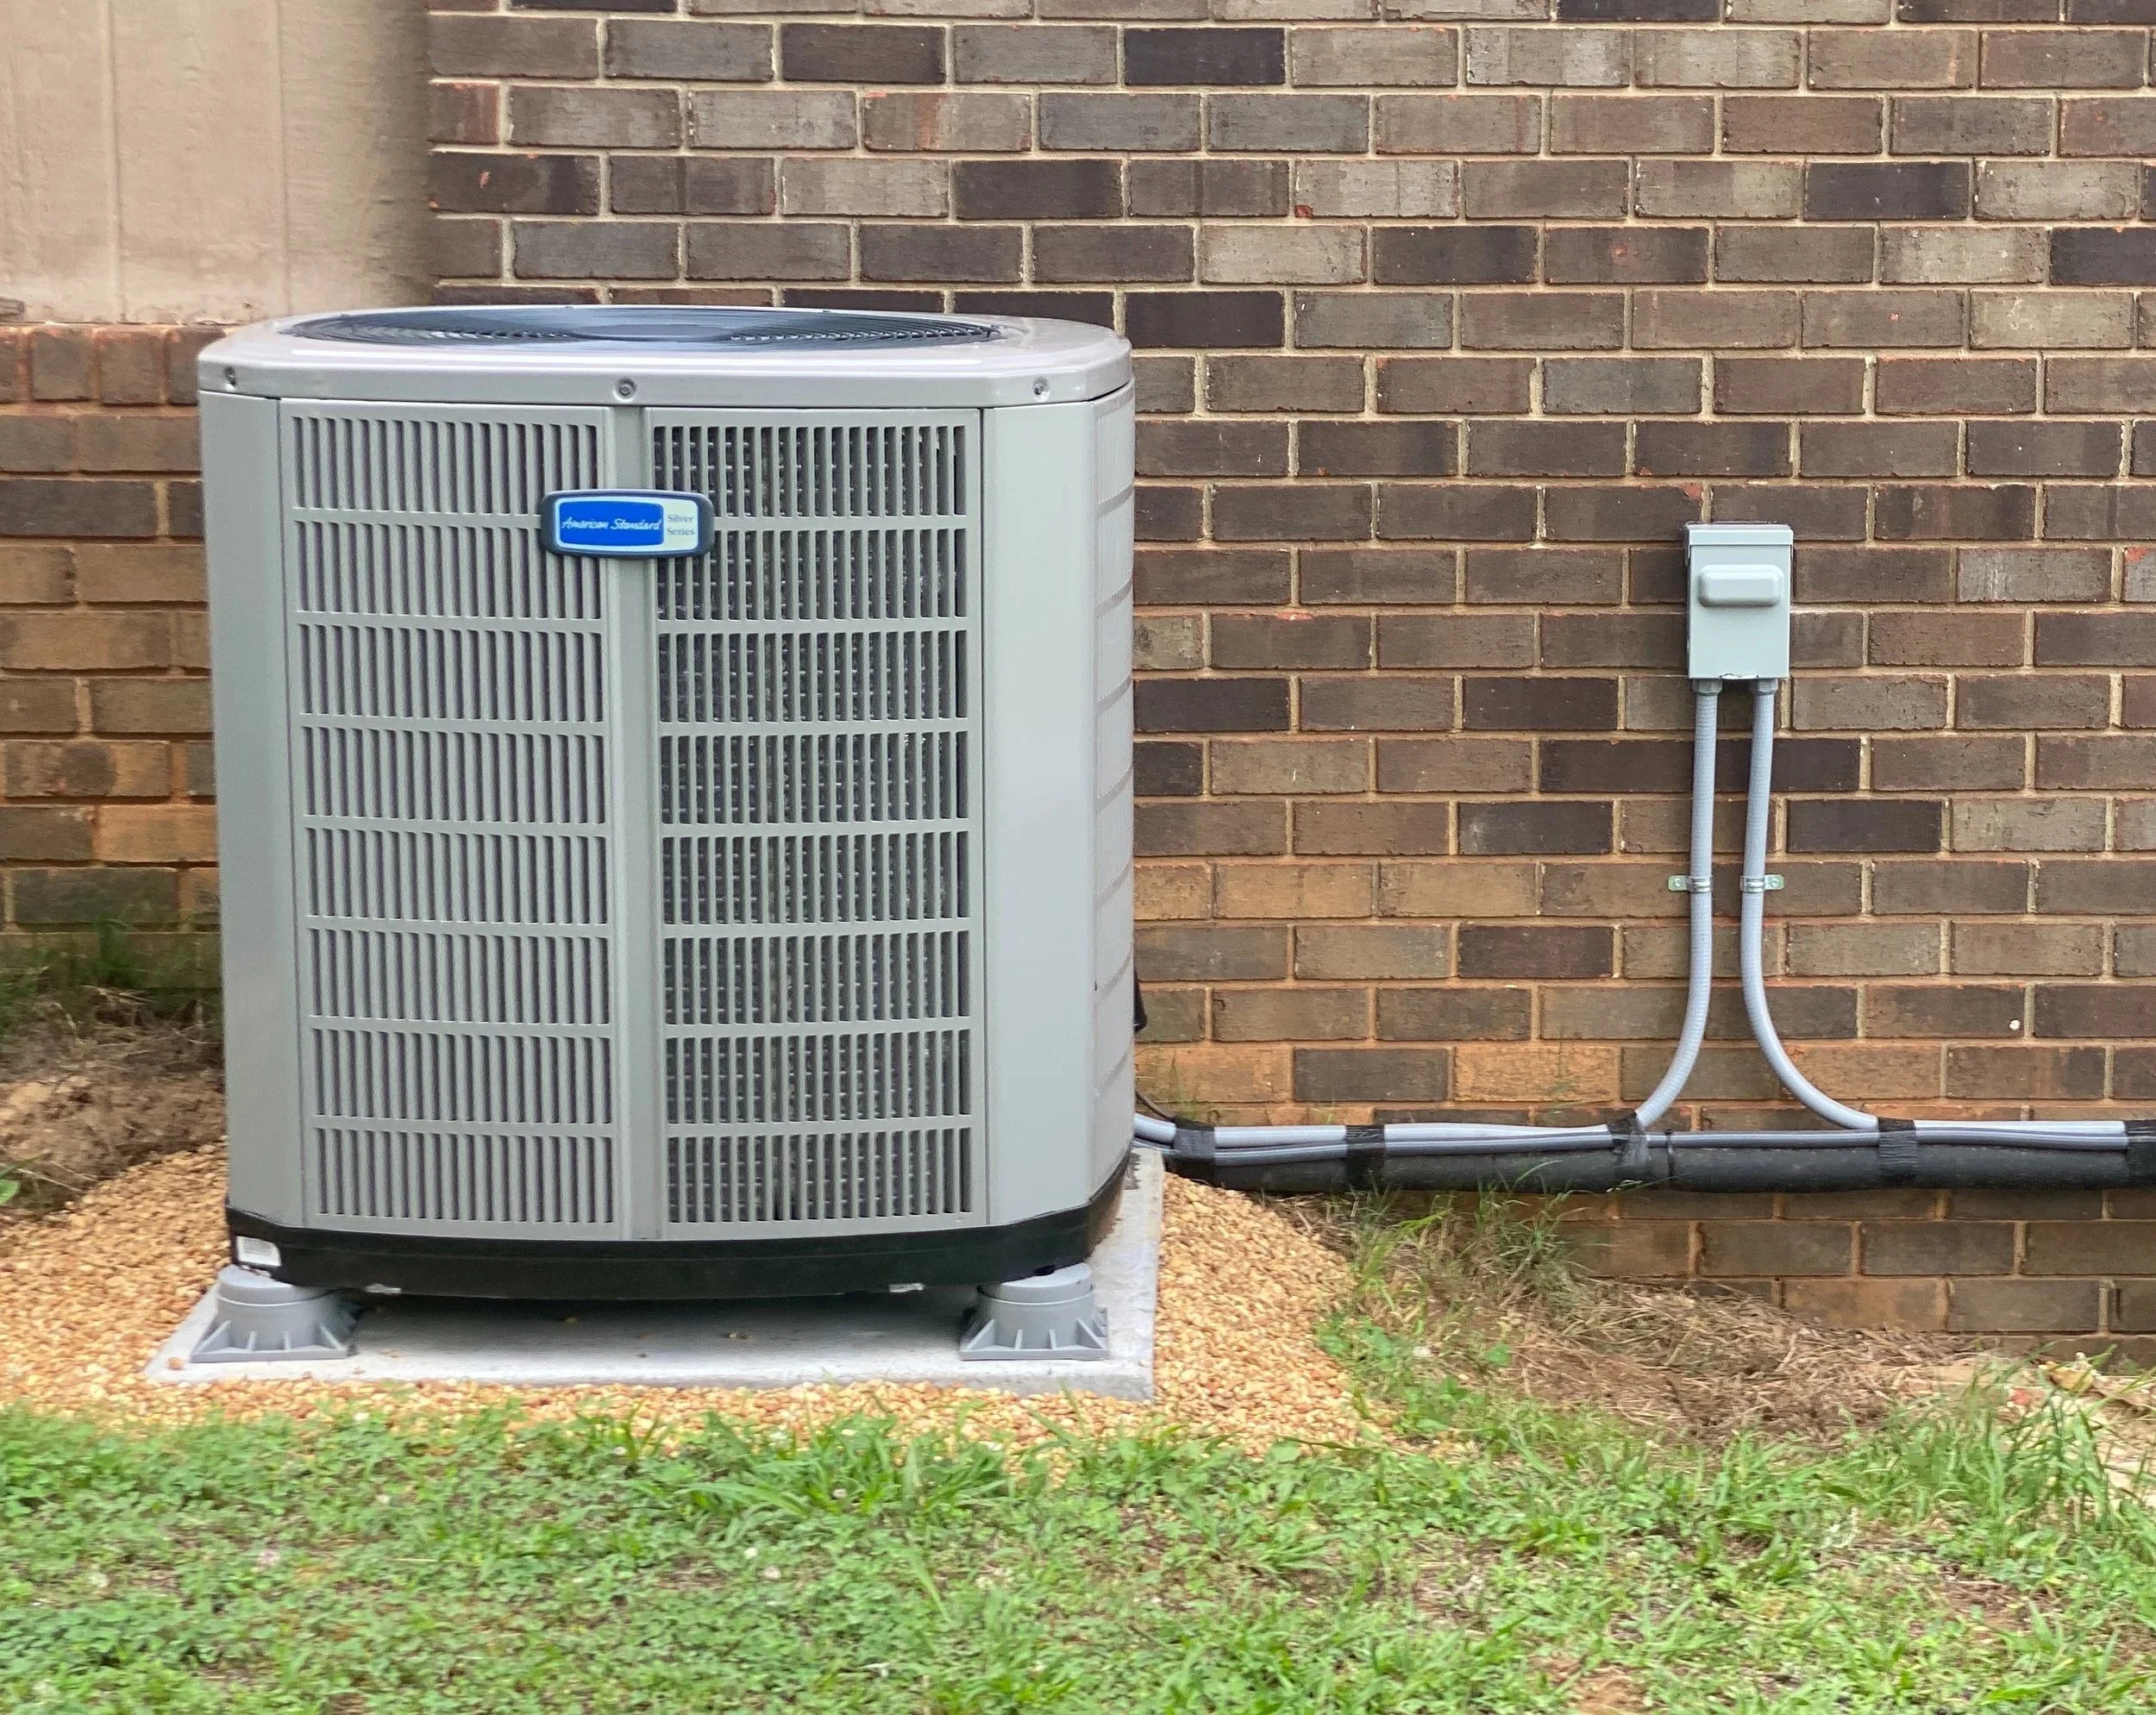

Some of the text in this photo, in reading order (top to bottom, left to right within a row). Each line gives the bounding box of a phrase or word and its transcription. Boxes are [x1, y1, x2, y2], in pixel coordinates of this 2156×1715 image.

[561, 516, 661, 530] American Standard
[668, 514, 693, 523] Silver
